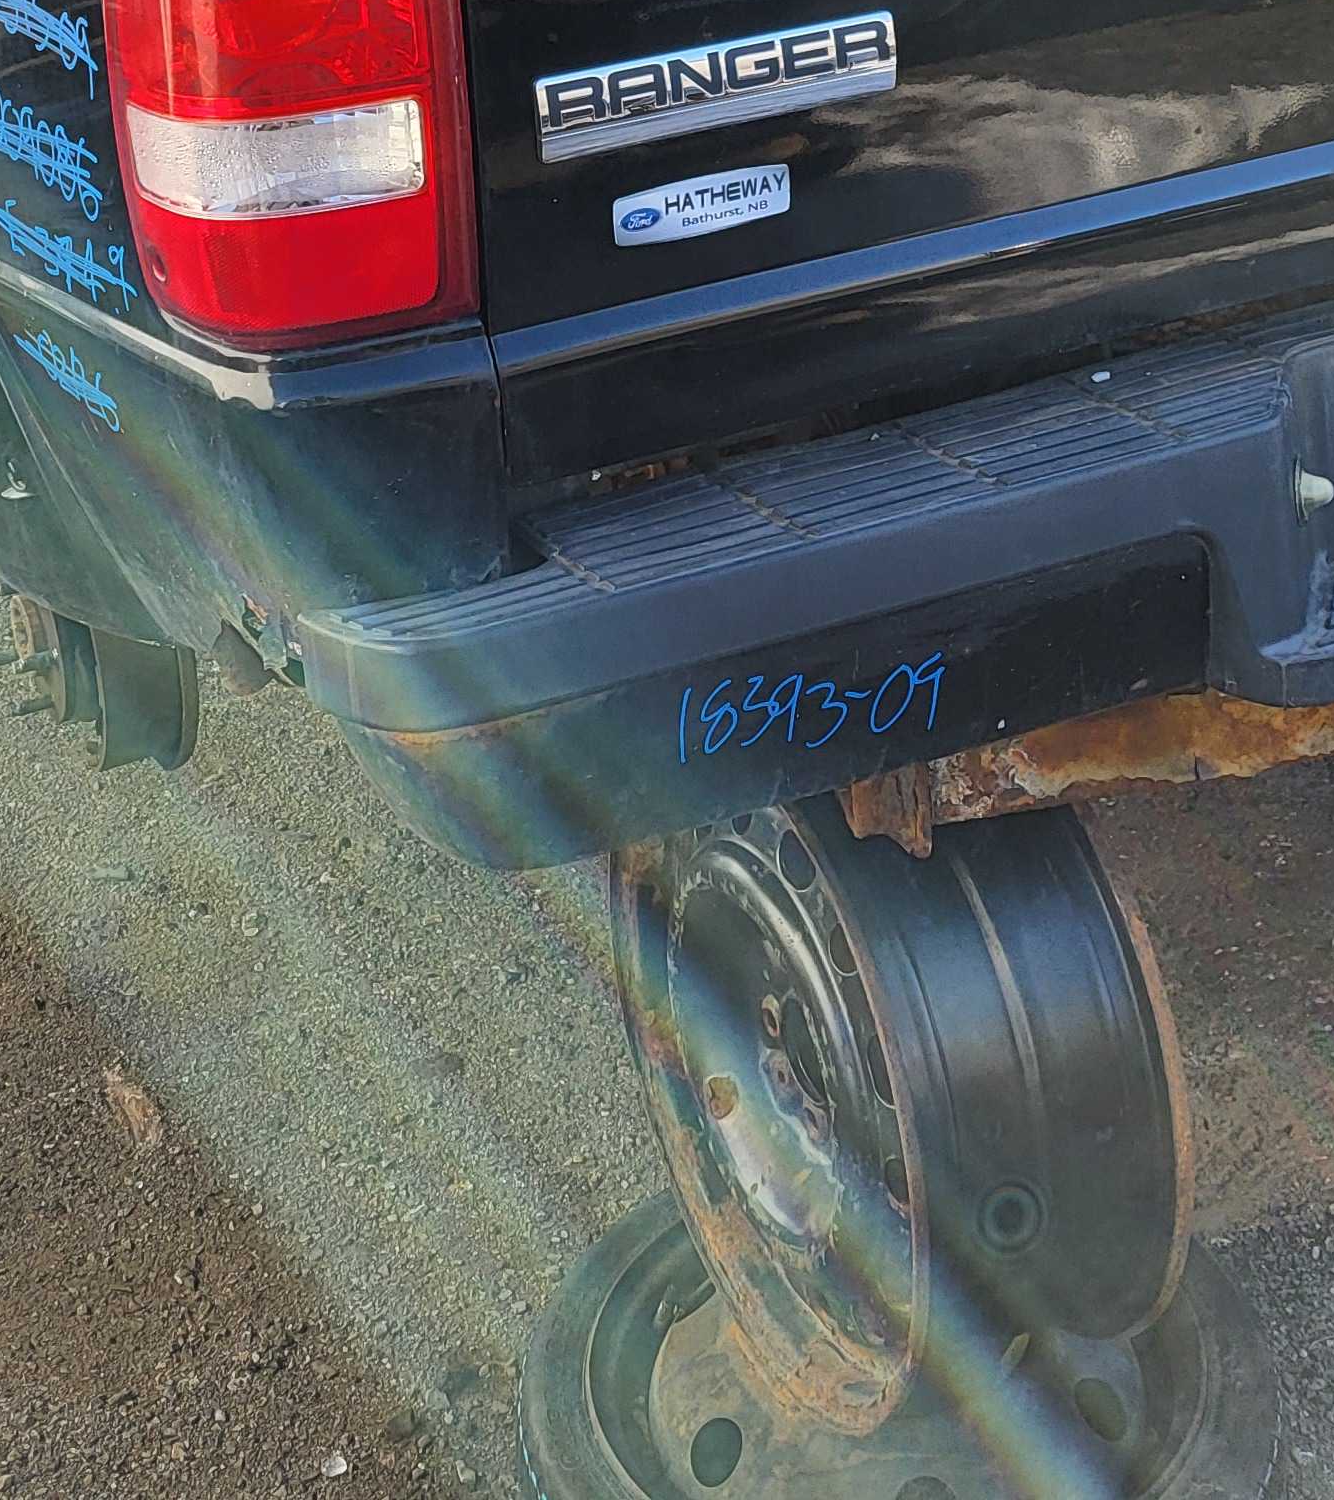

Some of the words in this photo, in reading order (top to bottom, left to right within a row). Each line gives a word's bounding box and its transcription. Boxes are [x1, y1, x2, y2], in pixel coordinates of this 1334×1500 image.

[545, 20, 890, 128] RANGER
[664, 171, 786, 216] HATHEWAY
[747, 199, 769, 213] NB
[627, 212, 654, 229] Ford
[678, 651, 946, 765] 18393-09
